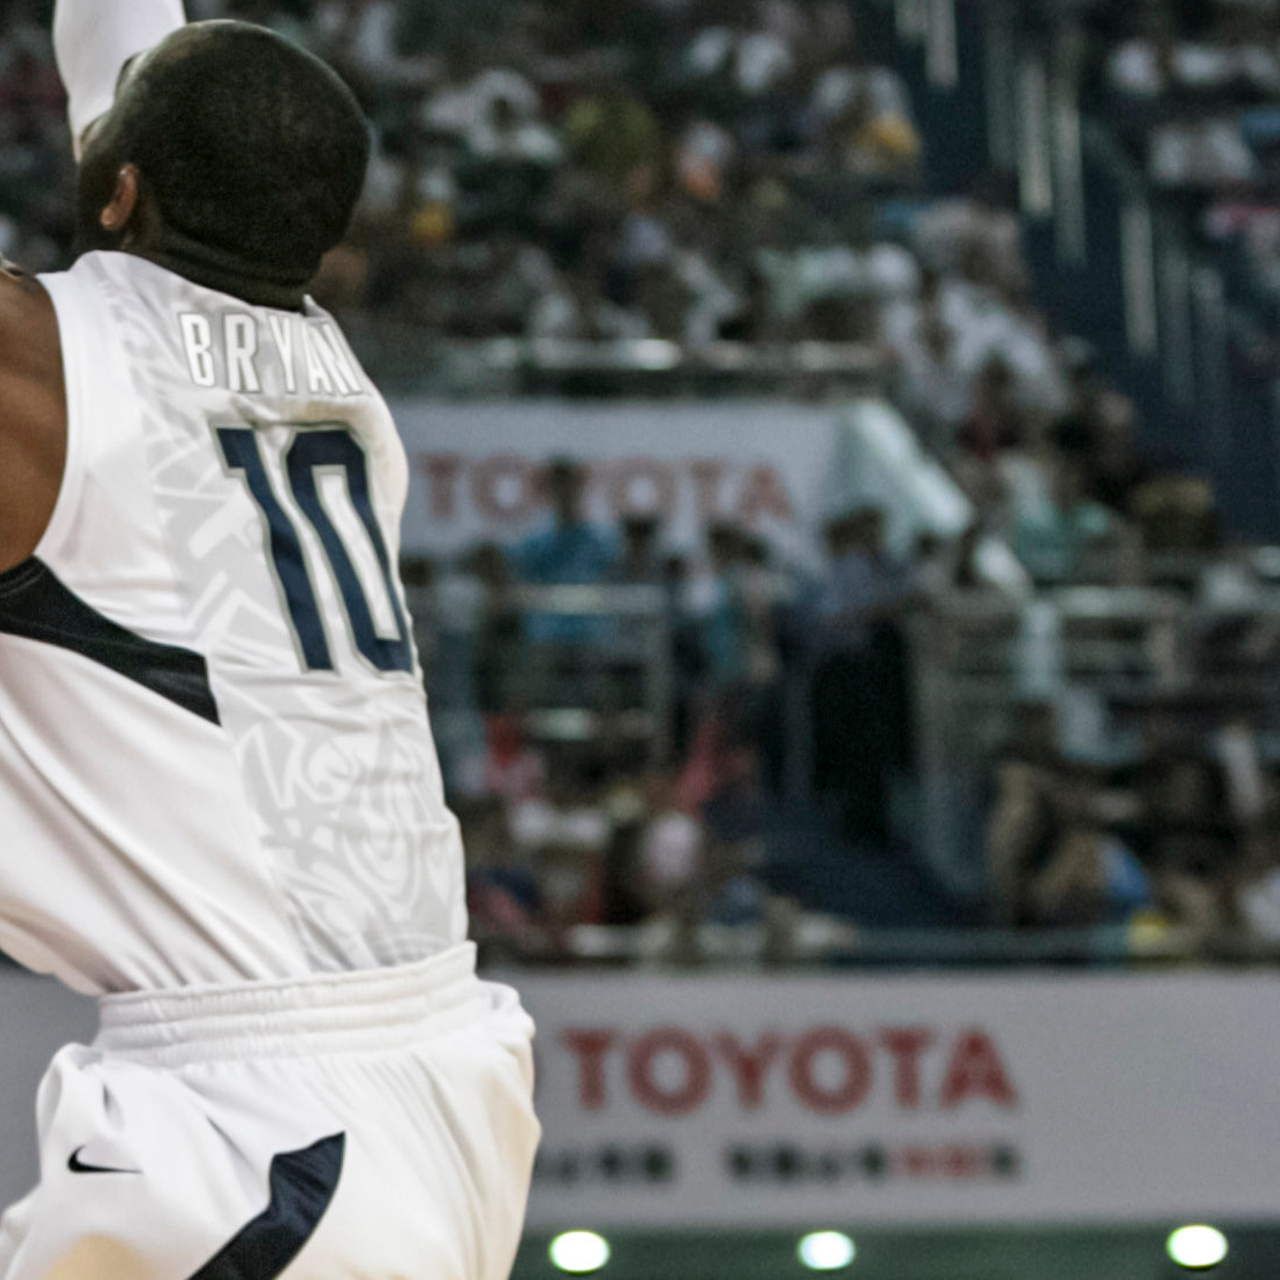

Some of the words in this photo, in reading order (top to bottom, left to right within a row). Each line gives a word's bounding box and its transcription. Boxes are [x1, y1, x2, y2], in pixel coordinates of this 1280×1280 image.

[178, 312, 365, 396] BRYAN
[423, 453, 795, 522] TOOTA
[211, 422, 418, 674] 10
[560, 1027, 1017, 1114] TOYOTA
